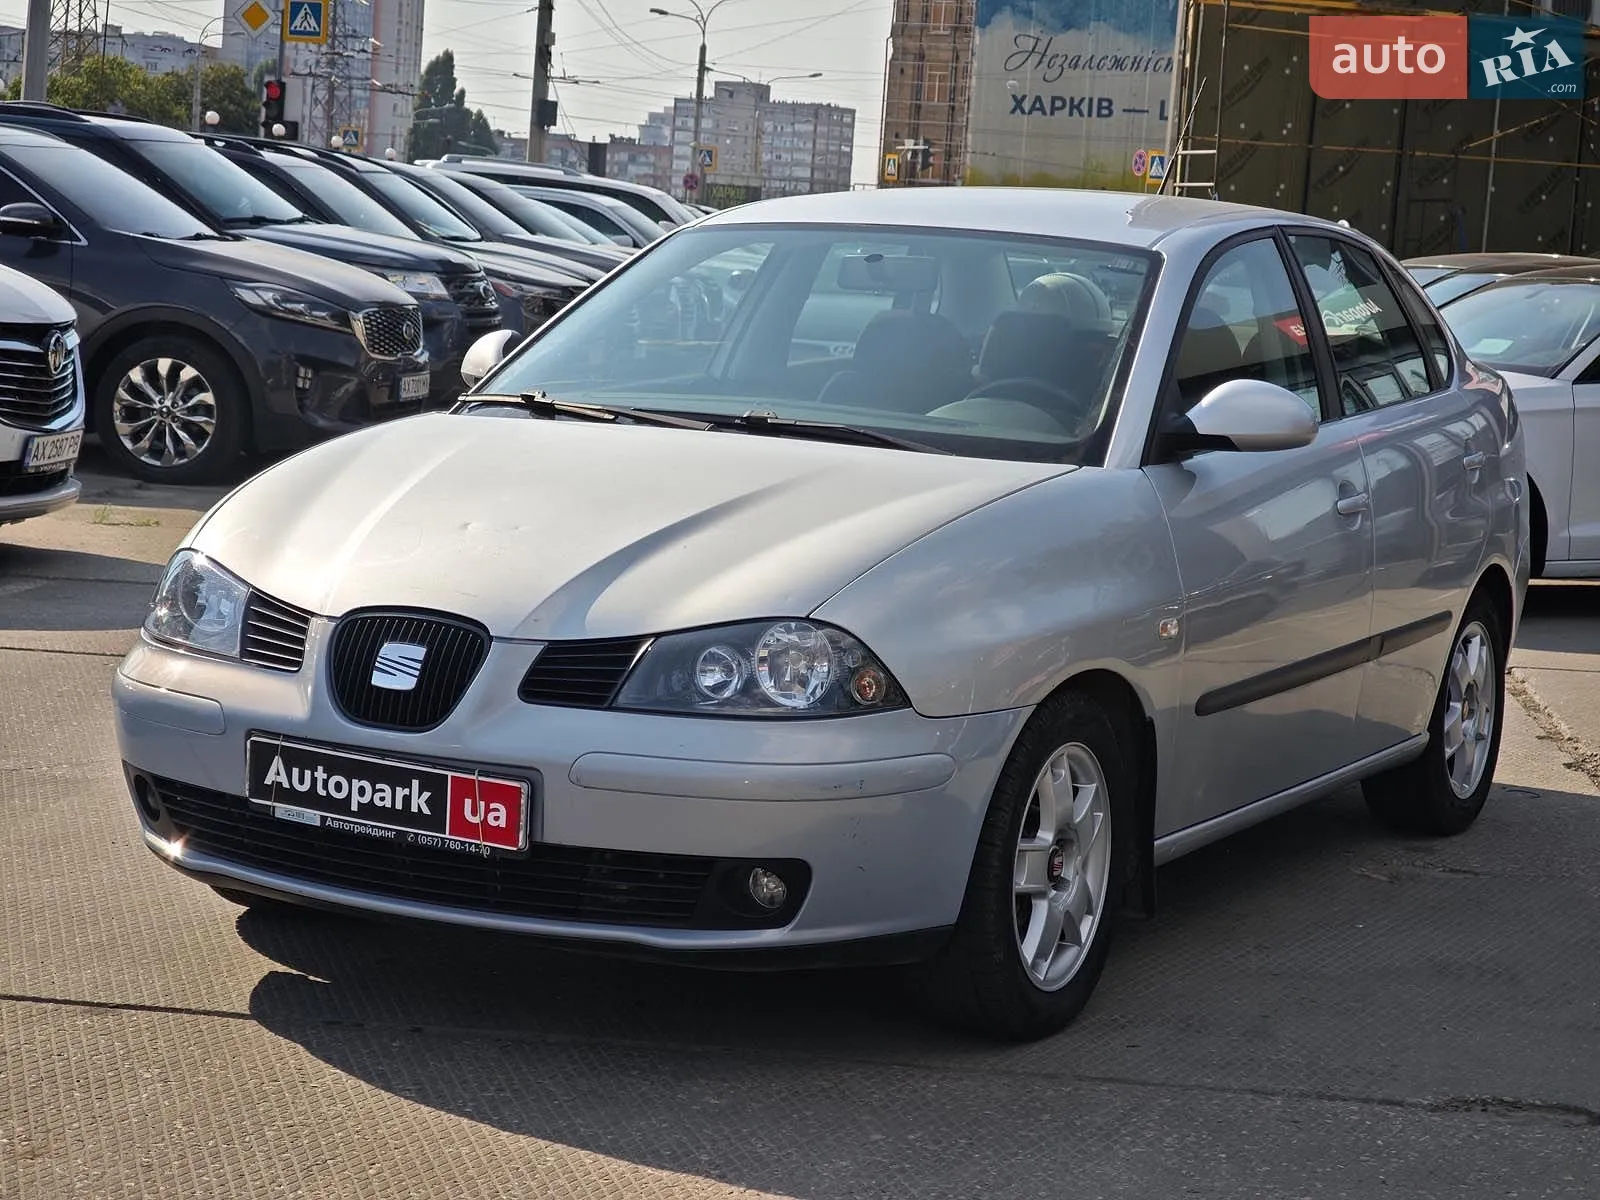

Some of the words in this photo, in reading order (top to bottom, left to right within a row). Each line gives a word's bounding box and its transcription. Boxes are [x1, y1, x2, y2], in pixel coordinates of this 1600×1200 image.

[1009, 94, 1114, 118] ХАРКІВ
[32, 441, 49, 461] AX
[264, 756, 432, 815] Autopark
[463, 797, 507, 828] ua
[325, 817, 397, 838] Автотрейдинг
[418, 834, 441, 847] (057)
